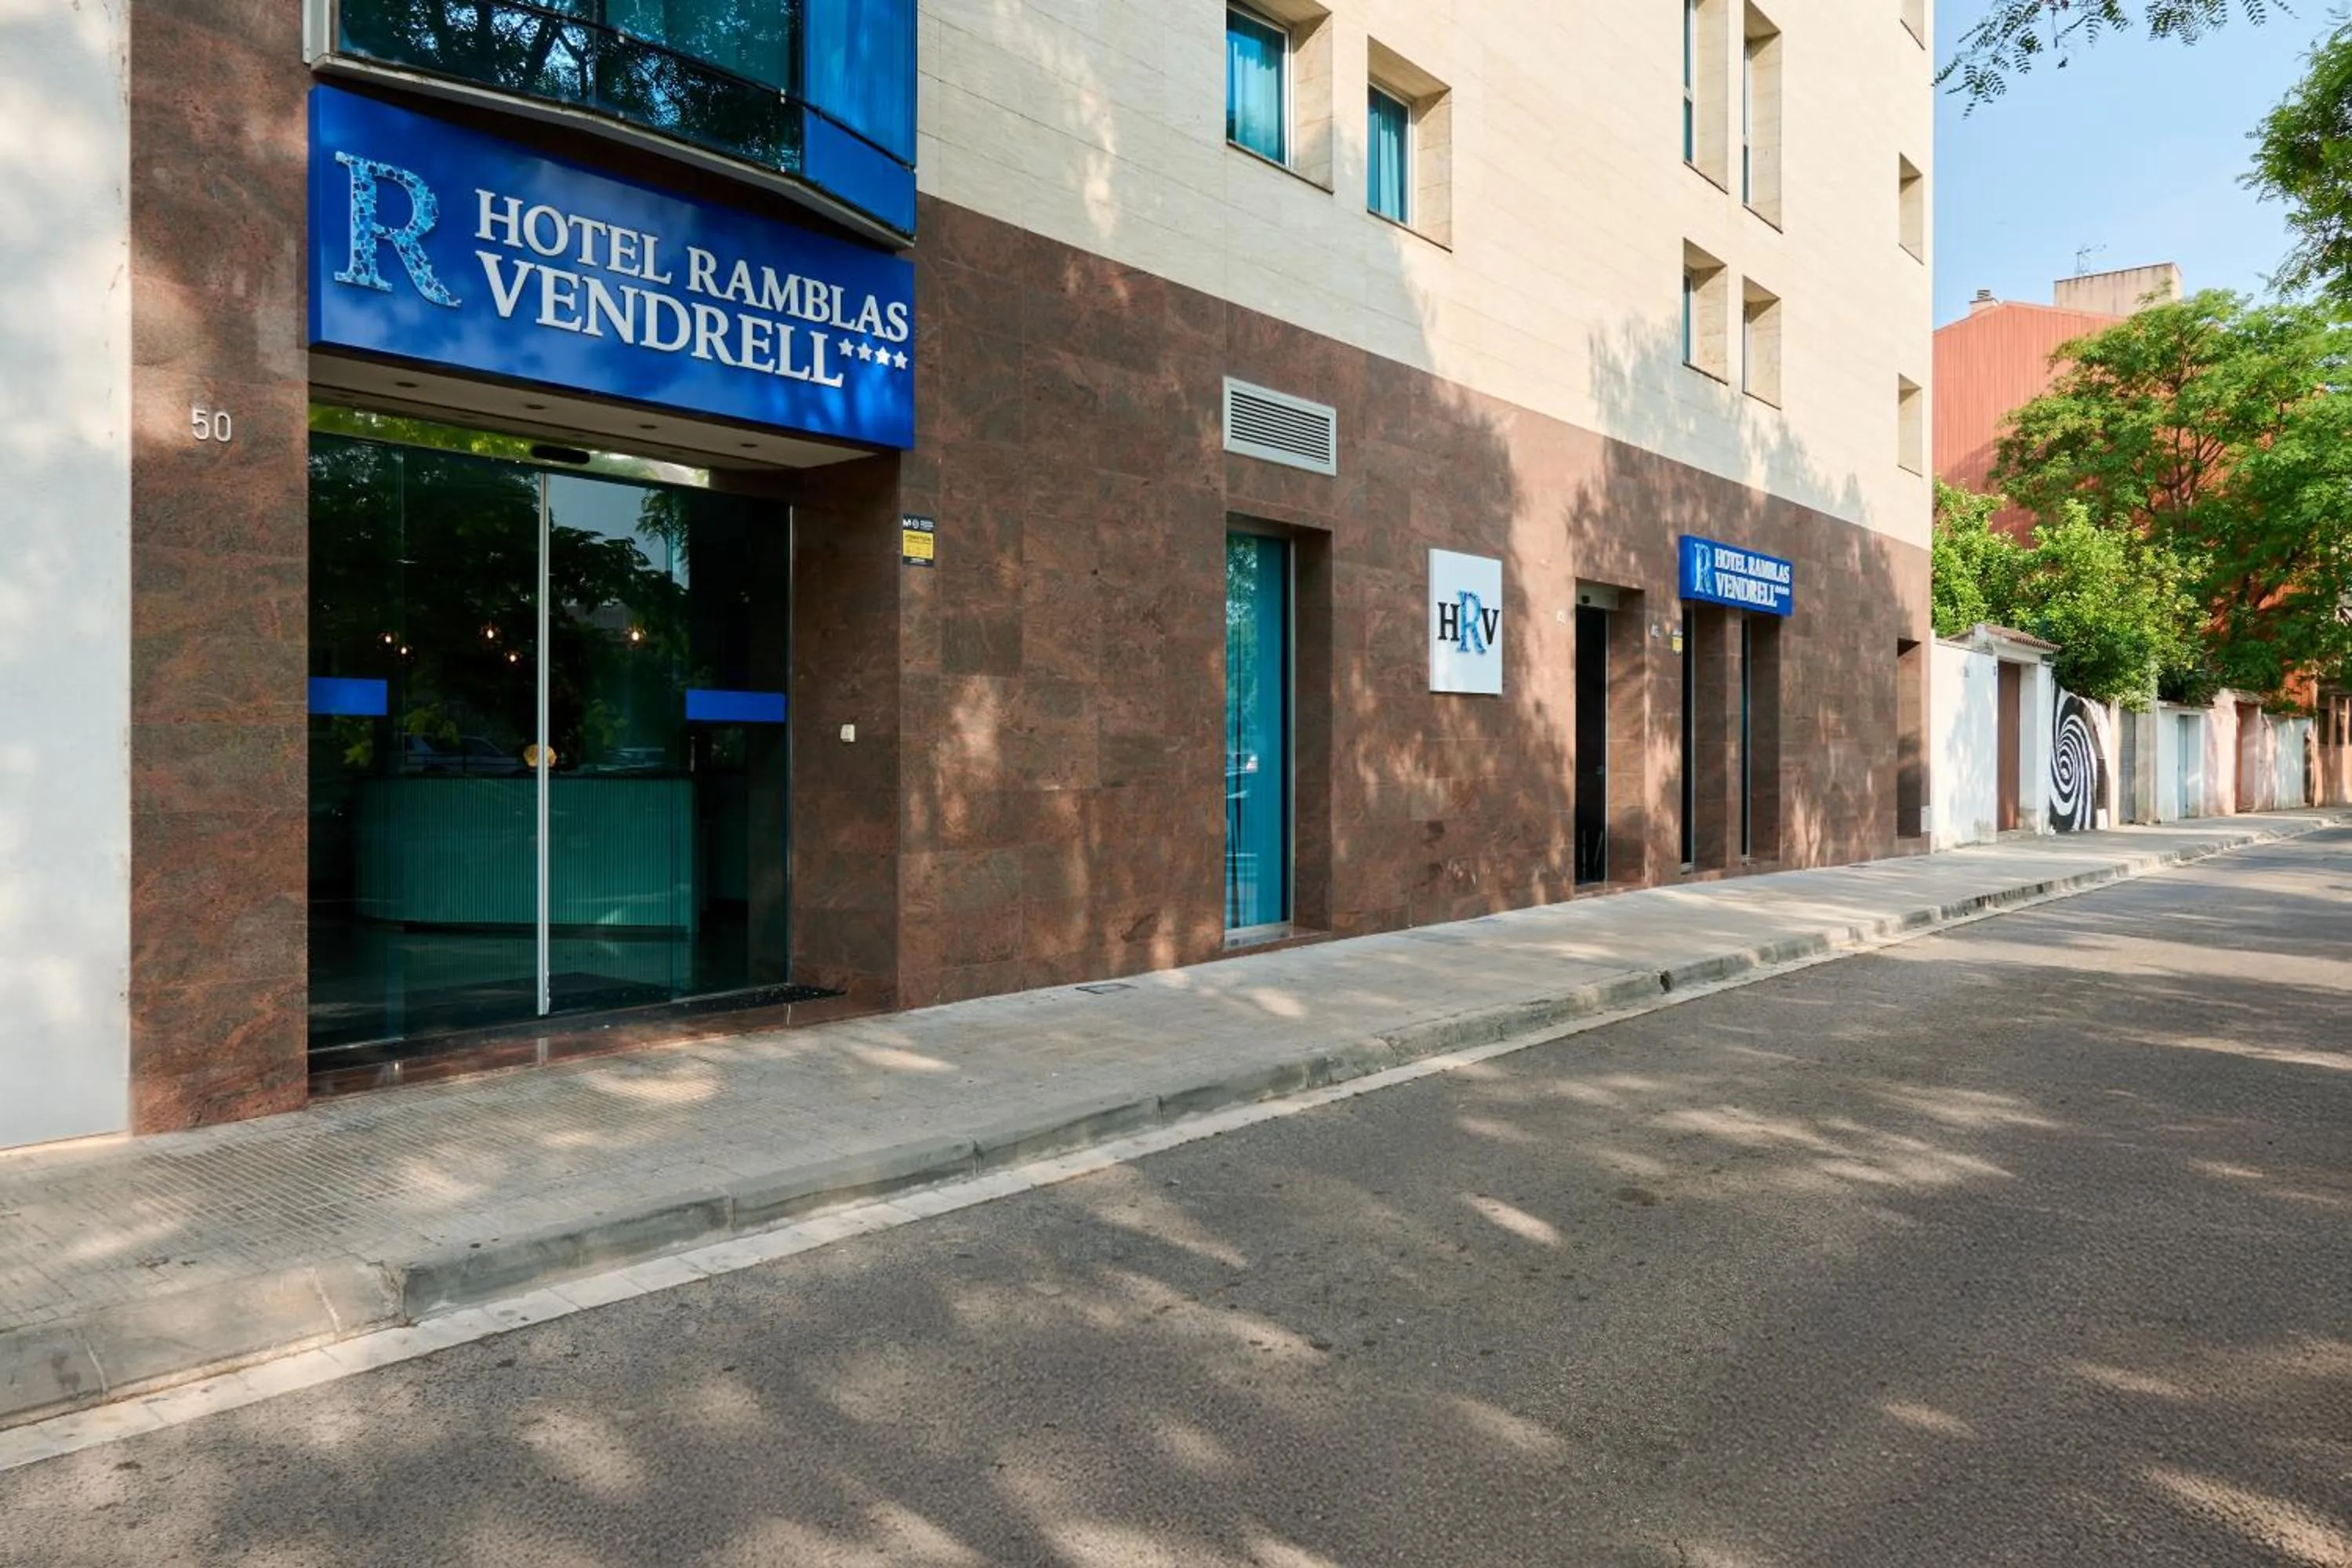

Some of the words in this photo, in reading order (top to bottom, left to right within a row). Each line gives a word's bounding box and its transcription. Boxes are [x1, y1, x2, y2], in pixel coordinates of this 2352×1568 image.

[336, 151, 461, 308] R
[475, 188, 672, 285] HOTEL
[687, 246, 909, 343] RAMBLAS
[476, 250, 844, 388] VENDRELL
[191, 408, 231, 441] 50
[1715, 548, 1748, 574] HOTEL
[1748, 556, 1790, 583] RAMBLAS
[1715, 572, 1777, 608] VENDRELL
